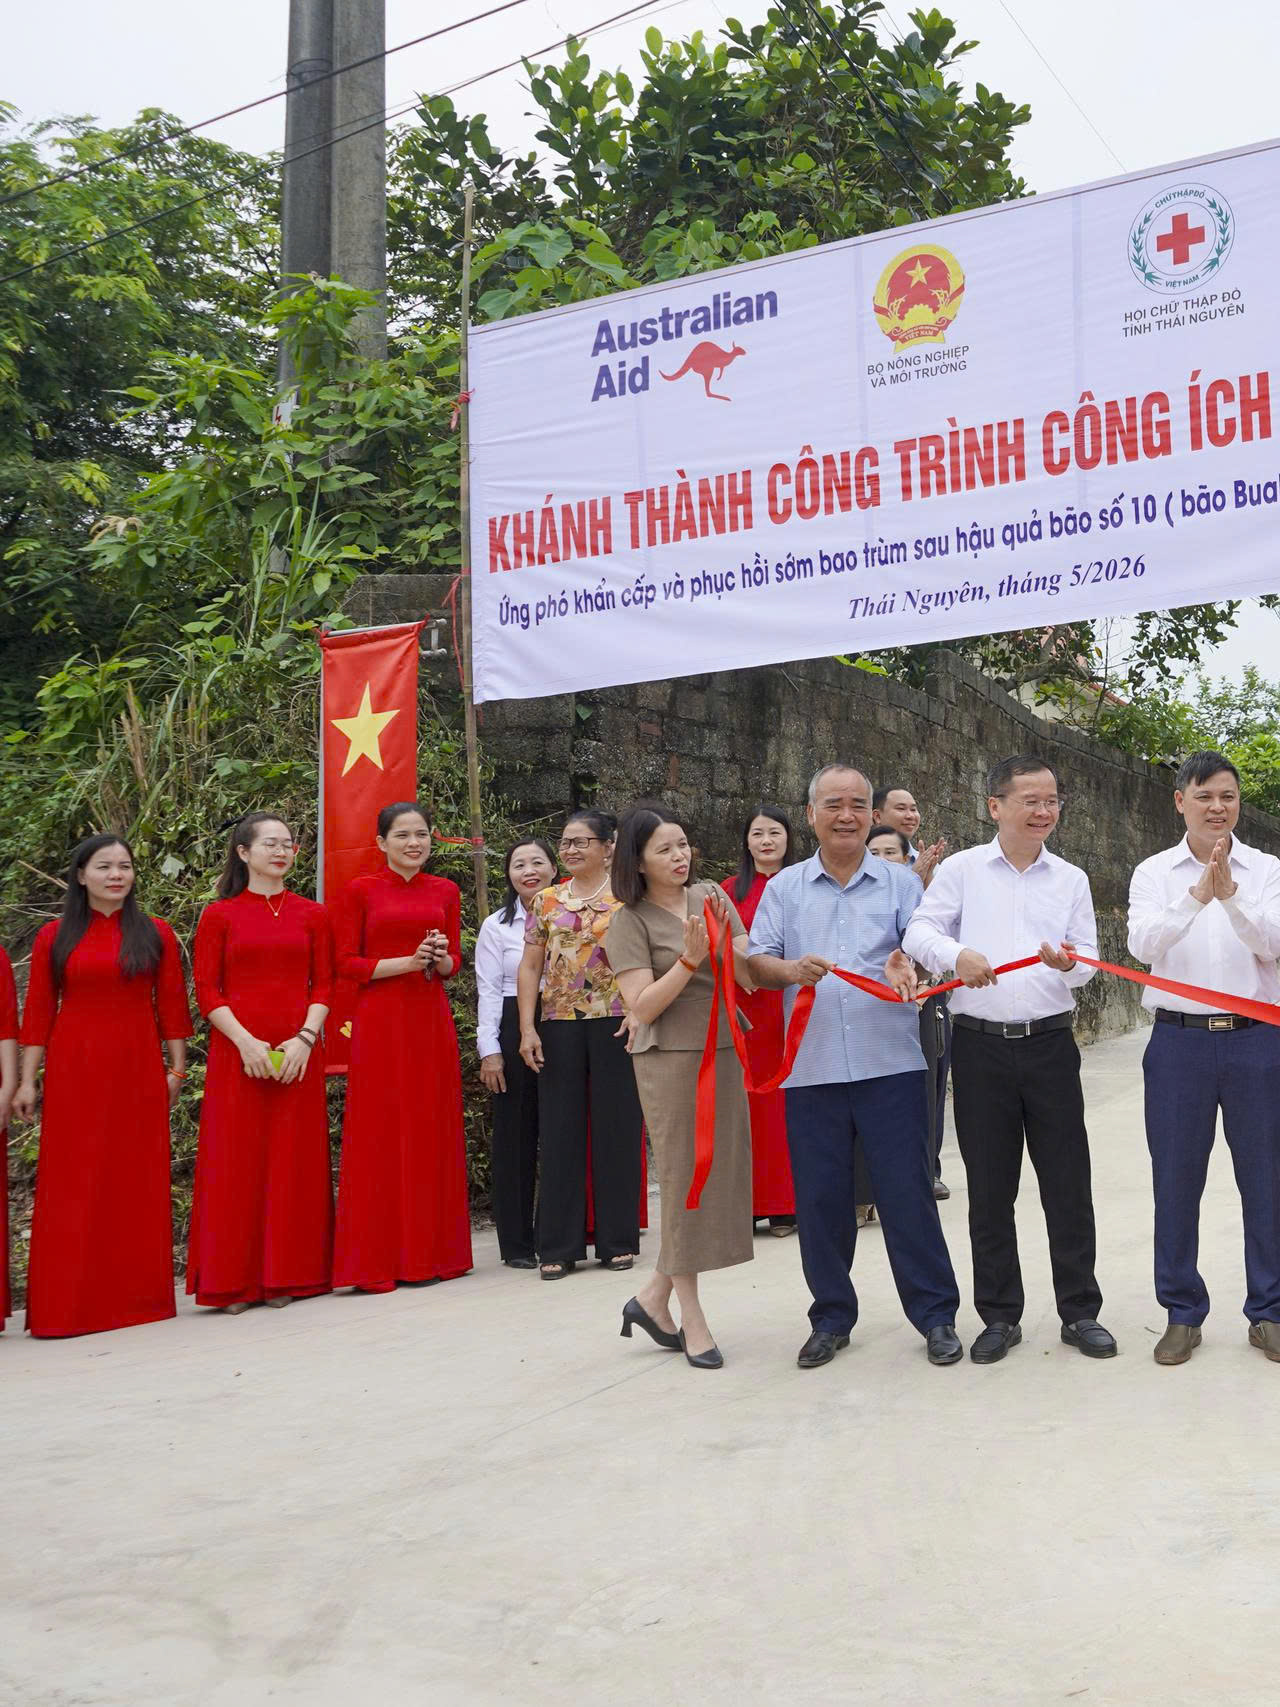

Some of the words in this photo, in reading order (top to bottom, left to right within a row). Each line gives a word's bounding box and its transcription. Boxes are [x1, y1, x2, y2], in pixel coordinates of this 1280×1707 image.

[591, 290, 778, 357] Australian
[1123, 321, 1151, 338] TỈNH
[1155, 314, 1185, 331] THÁI
[1190, 302, 1245, 325] NGUYÊN
[1124, 308, 1146, 324] HỘI
[1151, 301, 1180, 317] CHỮ
[1184, 293, 1218, 311] THẬP
[1222, 287, 1242, 302] ĐỎ
[591, 355, 649, 402] Aid
[867, 363, 884, 377] BỘ
[888, 355, 921, 372] NÔNG
[925, 345, 970, 363] NGHIỆP
[871, 373, 887, 389] VÀ
[890, 369, 911, 385] MÔI
[915, 359, 968, 380] TRƯỜNG
[488, 493, 613, 574] KHÁNH
[624, 469, 754, 550] THÀNH
[767, 444, 881, 525] CÔNG
[894, 416, 1026, 502] TRÌNH
[1042, 390, 1172, 476] CÔNG
[1188, 369, 1272, 452] ÍCH
[499, 594, 530, 630] Ứng
[535, 590, 569, 625] phó
[574, 577, 616, 614] khẩn
[621, 573, 656, 609] cấp
[662, 572, 684, 601] và
[691, 570, 736, 602] phục
[741, 551, 769, 589] hồi
[775, 552, 814, 584] sớm
[819, 550, 858, 576] bao
[863, 537, 908, 569] trùm
[914, 533, 949, 560] sau
[956, 521, 995, 559] hậu
[1002, 509, 1043, 551] quả
[1049, 507, 1092, 539] bão
[1099, 492, 1125, 531] số
[1131, 494, 1157, 525] 10
[1181, 485, 1226, 517] bão
[849, 591, 896, 620] Thái
[902, 581, 990, 615] Nguyên,
[998, 571, 1062, 596] tháng
[1069, 554, 1146, 588] 5/2026
